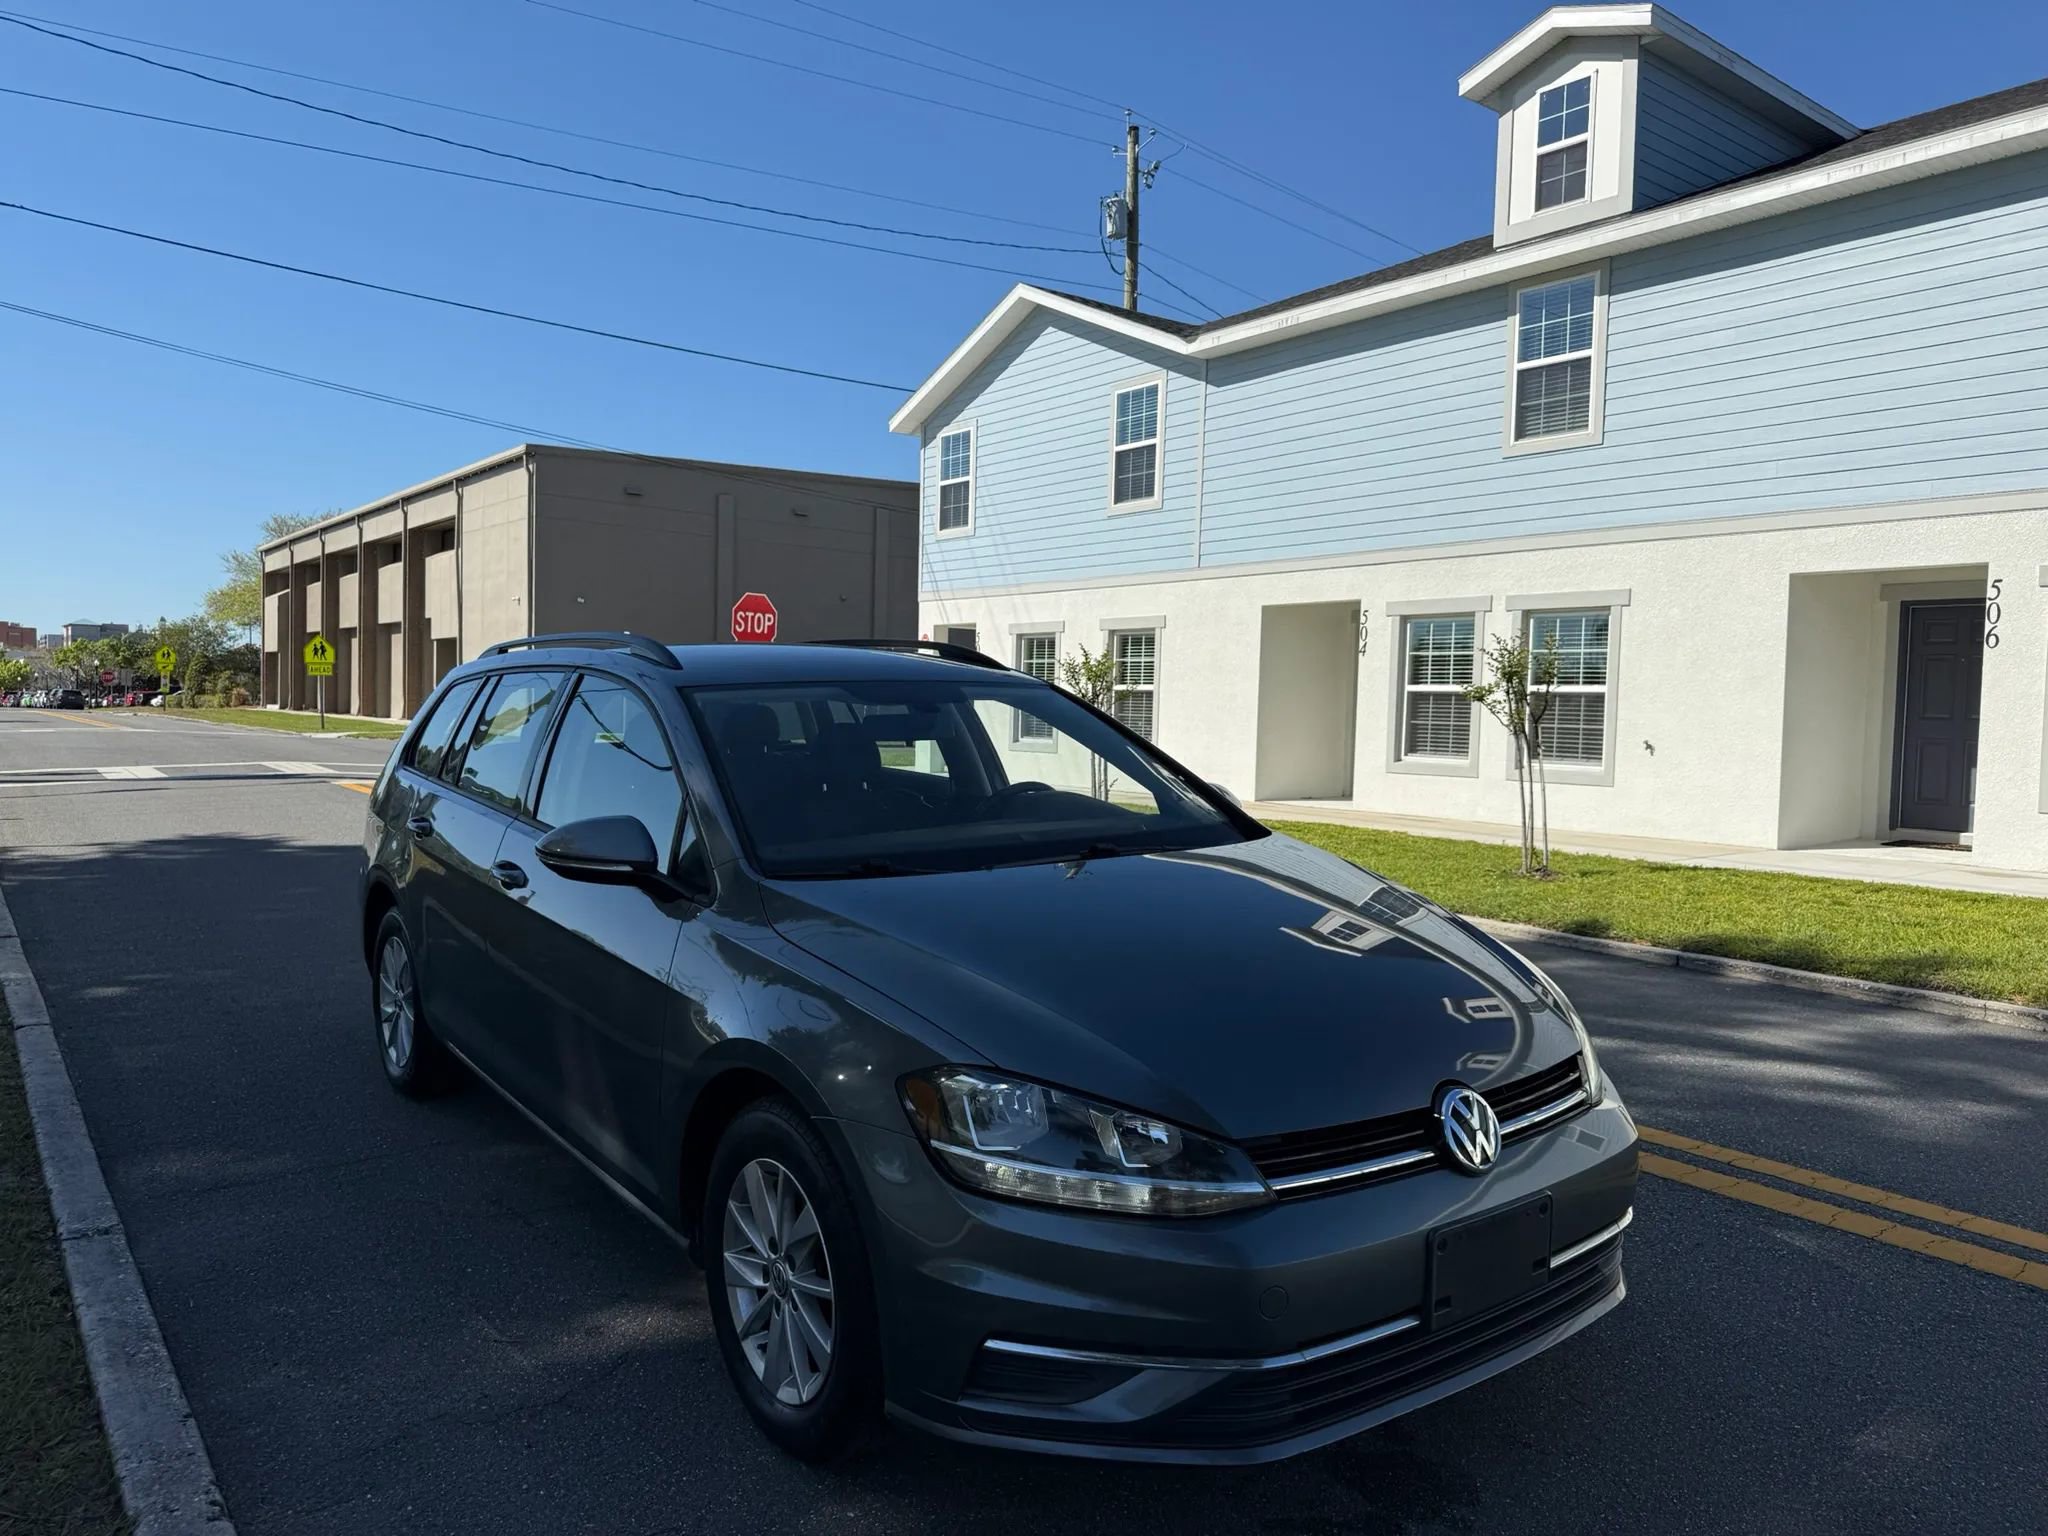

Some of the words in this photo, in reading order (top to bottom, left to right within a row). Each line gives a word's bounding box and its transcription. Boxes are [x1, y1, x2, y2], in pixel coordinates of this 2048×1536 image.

[735, 611, 774, 634] STOP
[1985, 579, 2003, 649] 506
[1359, 609, 1369, 656] 504
[309, 665, 331, 673] AHEAD
